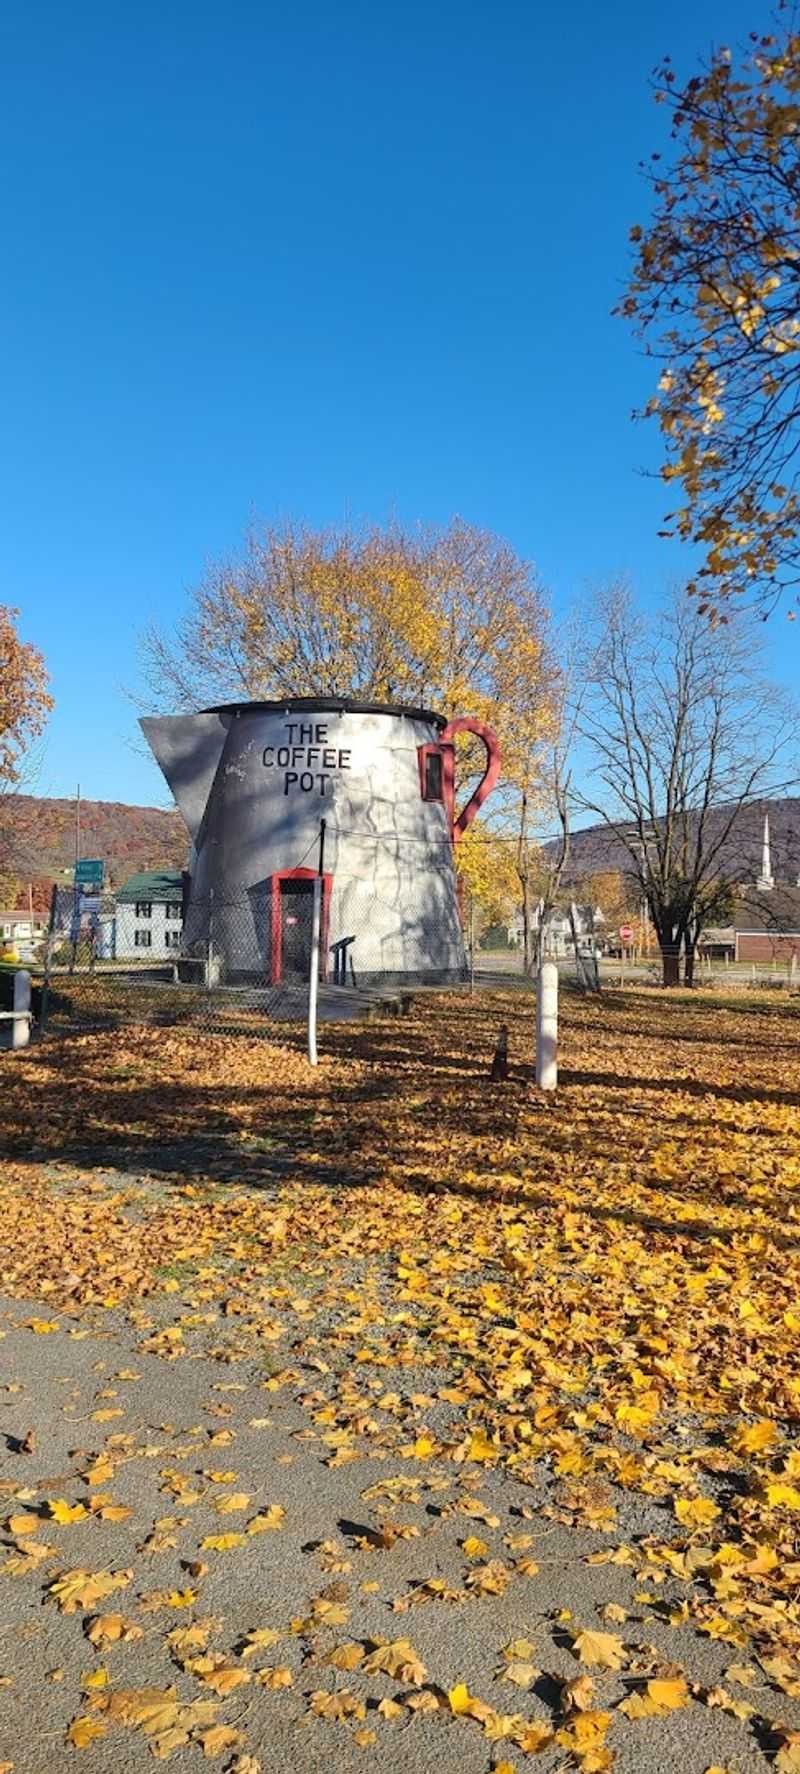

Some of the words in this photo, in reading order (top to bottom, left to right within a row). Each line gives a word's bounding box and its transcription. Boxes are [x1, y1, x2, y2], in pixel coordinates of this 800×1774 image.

[284, 724, 328, 745] THE
[262, 747, 352, 769] COFFEE
[284, 772, 330, 796] POT
